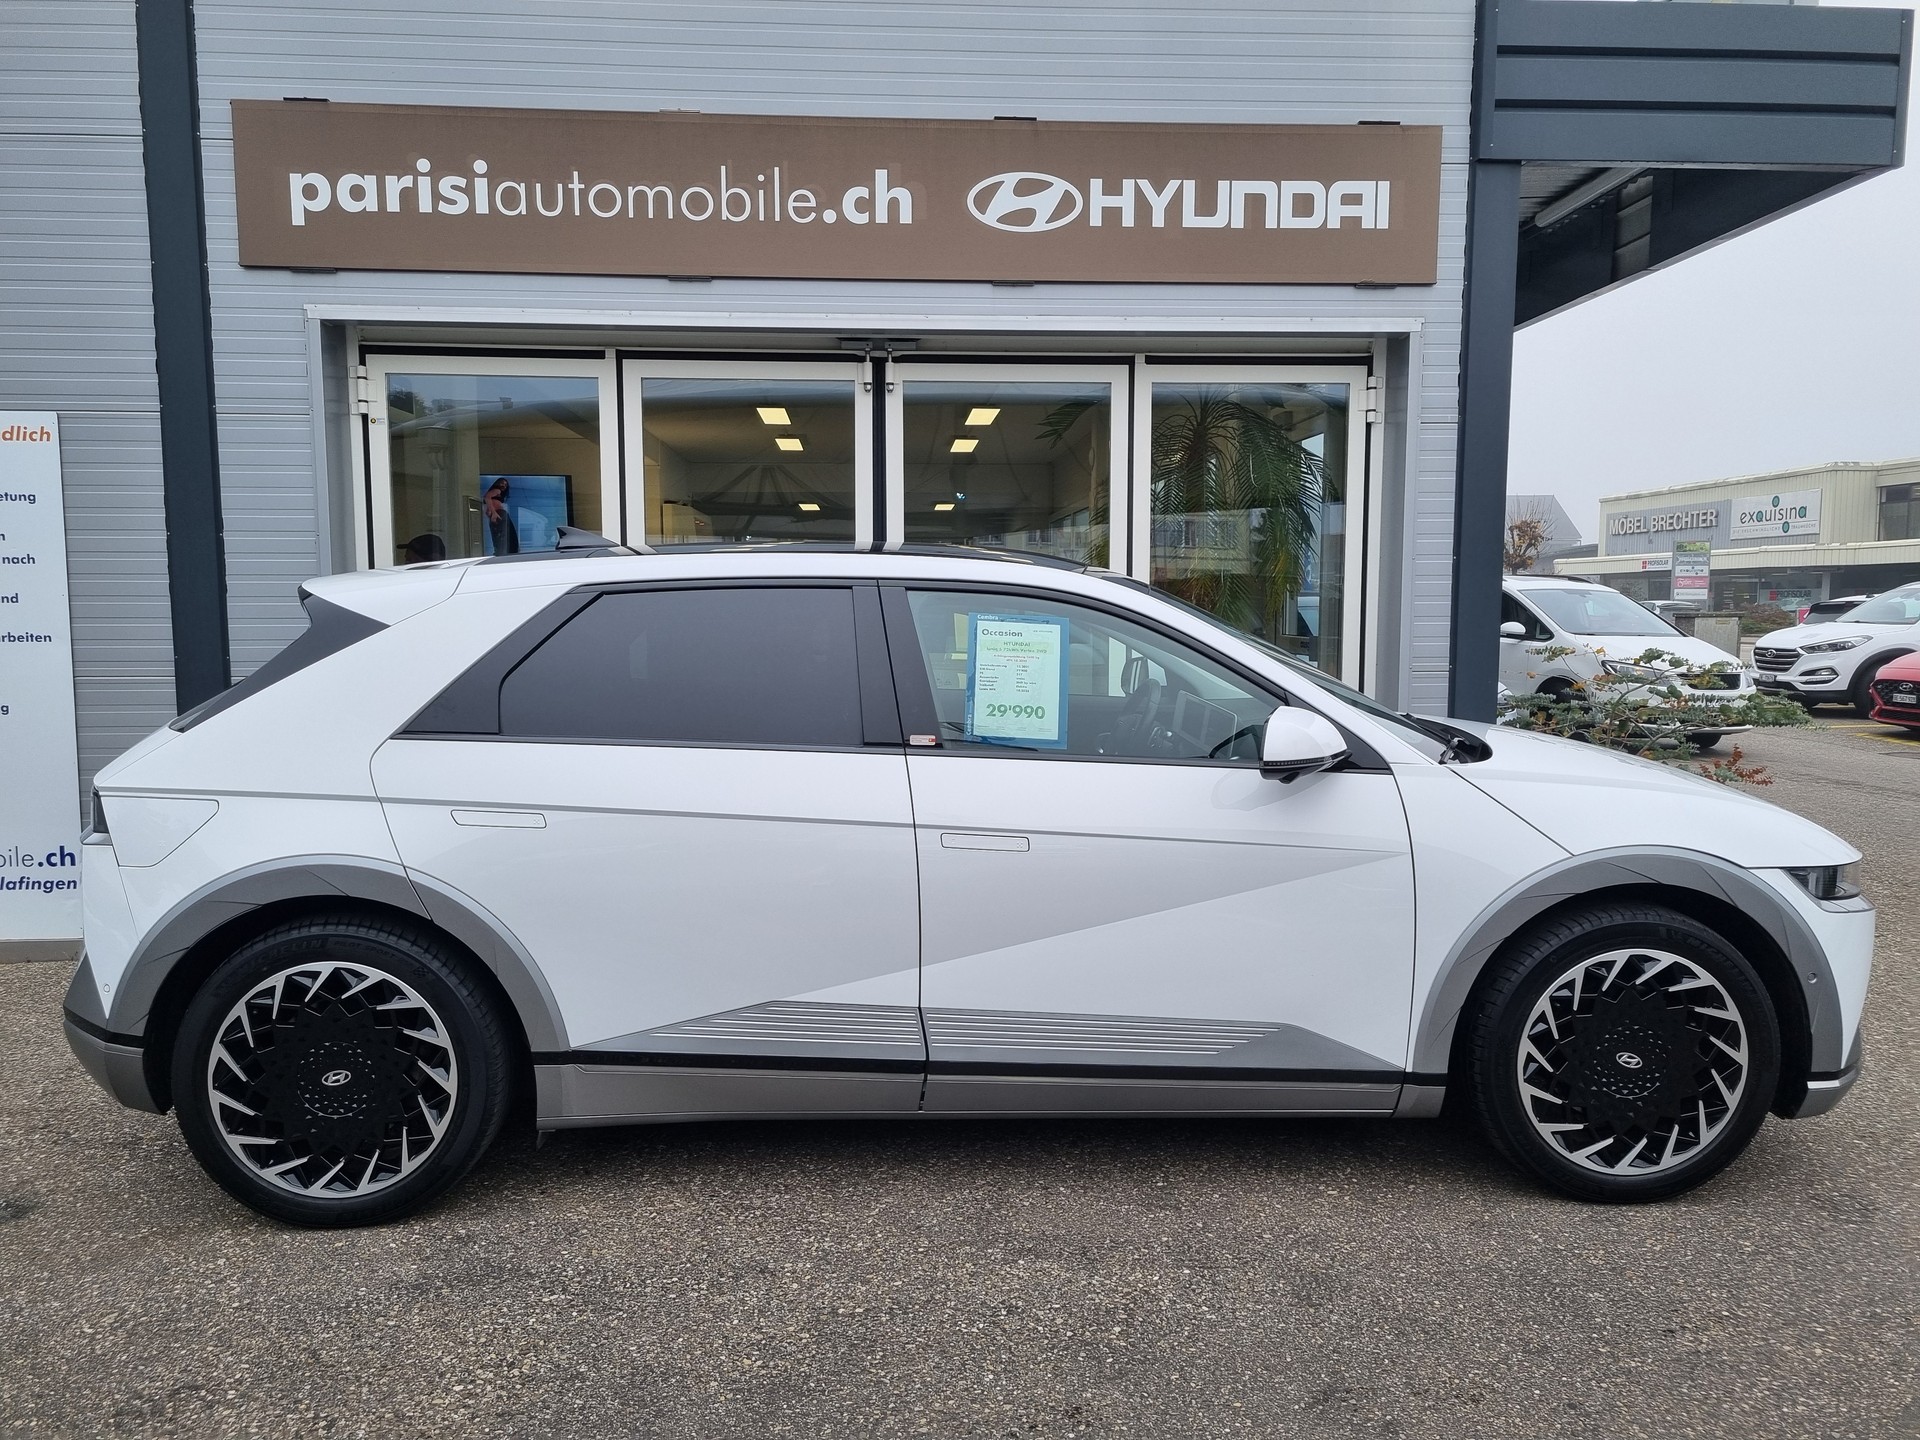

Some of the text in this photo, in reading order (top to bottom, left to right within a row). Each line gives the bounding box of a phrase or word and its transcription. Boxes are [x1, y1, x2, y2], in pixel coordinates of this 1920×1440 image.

[289, 158, 1390, 229] parisiautomobile.ch HYUNDAI
[1, 425, 51, 442] dlich
[1609, 509, 1718, 536] MÖBEL BRECHTER
[2, 553, 36, 565] nach
[1776, 590, 1811, 598] PROFISOLAR
[981, 628, 1023, 638] Occasion
[986, 703, 1046, 720] 29'990
[0, 876, 77, 893] lafingen
